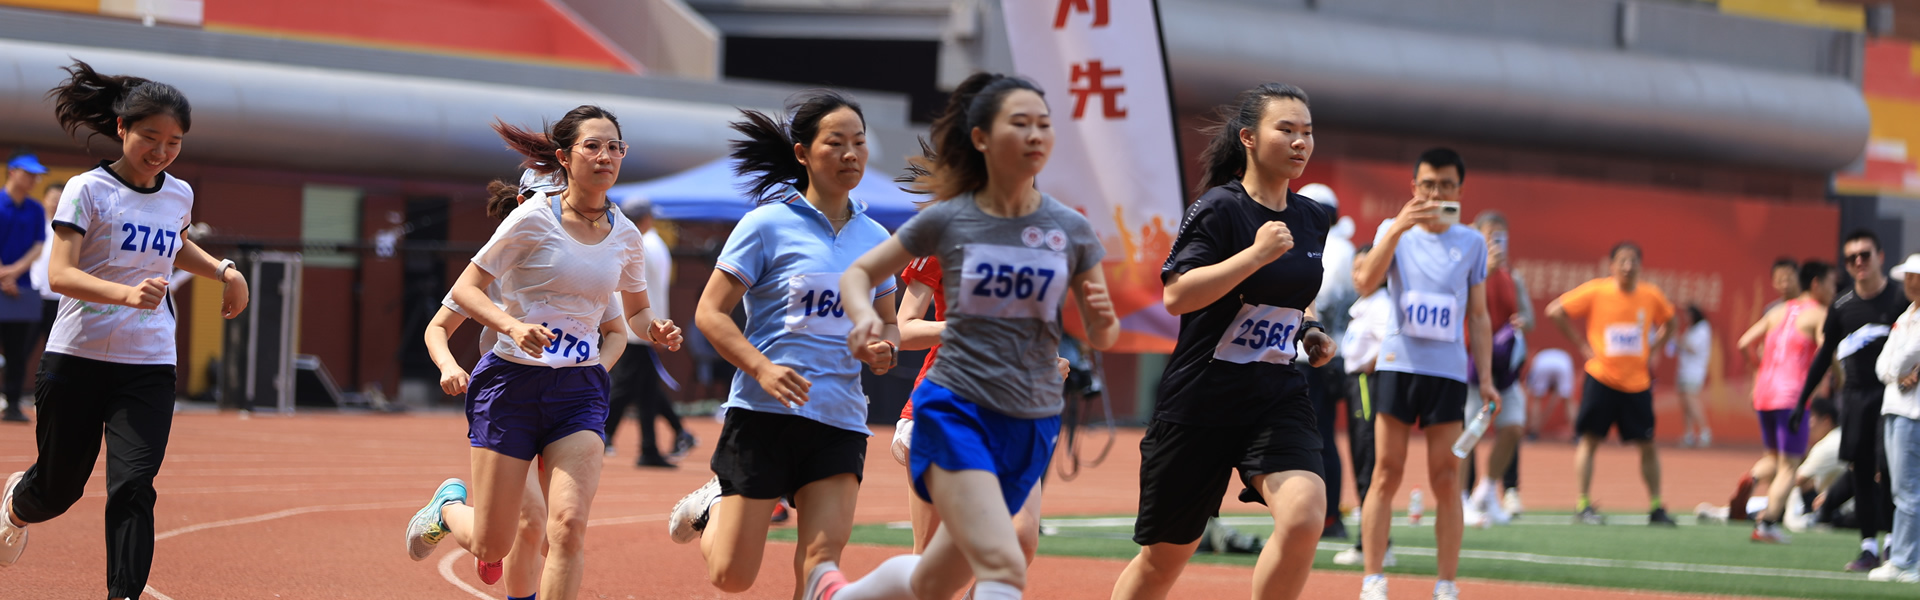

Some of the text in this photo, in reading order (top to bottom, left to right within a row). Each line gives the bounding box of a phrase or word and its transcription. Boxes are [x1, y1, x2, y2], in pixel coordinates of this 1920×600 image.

[121, 222, 176, 258] 2747
[972, 263, 1055, 302] 2567
[1406, 304, 1450, 328] 1018
[541, 321, 590, 364] 979
